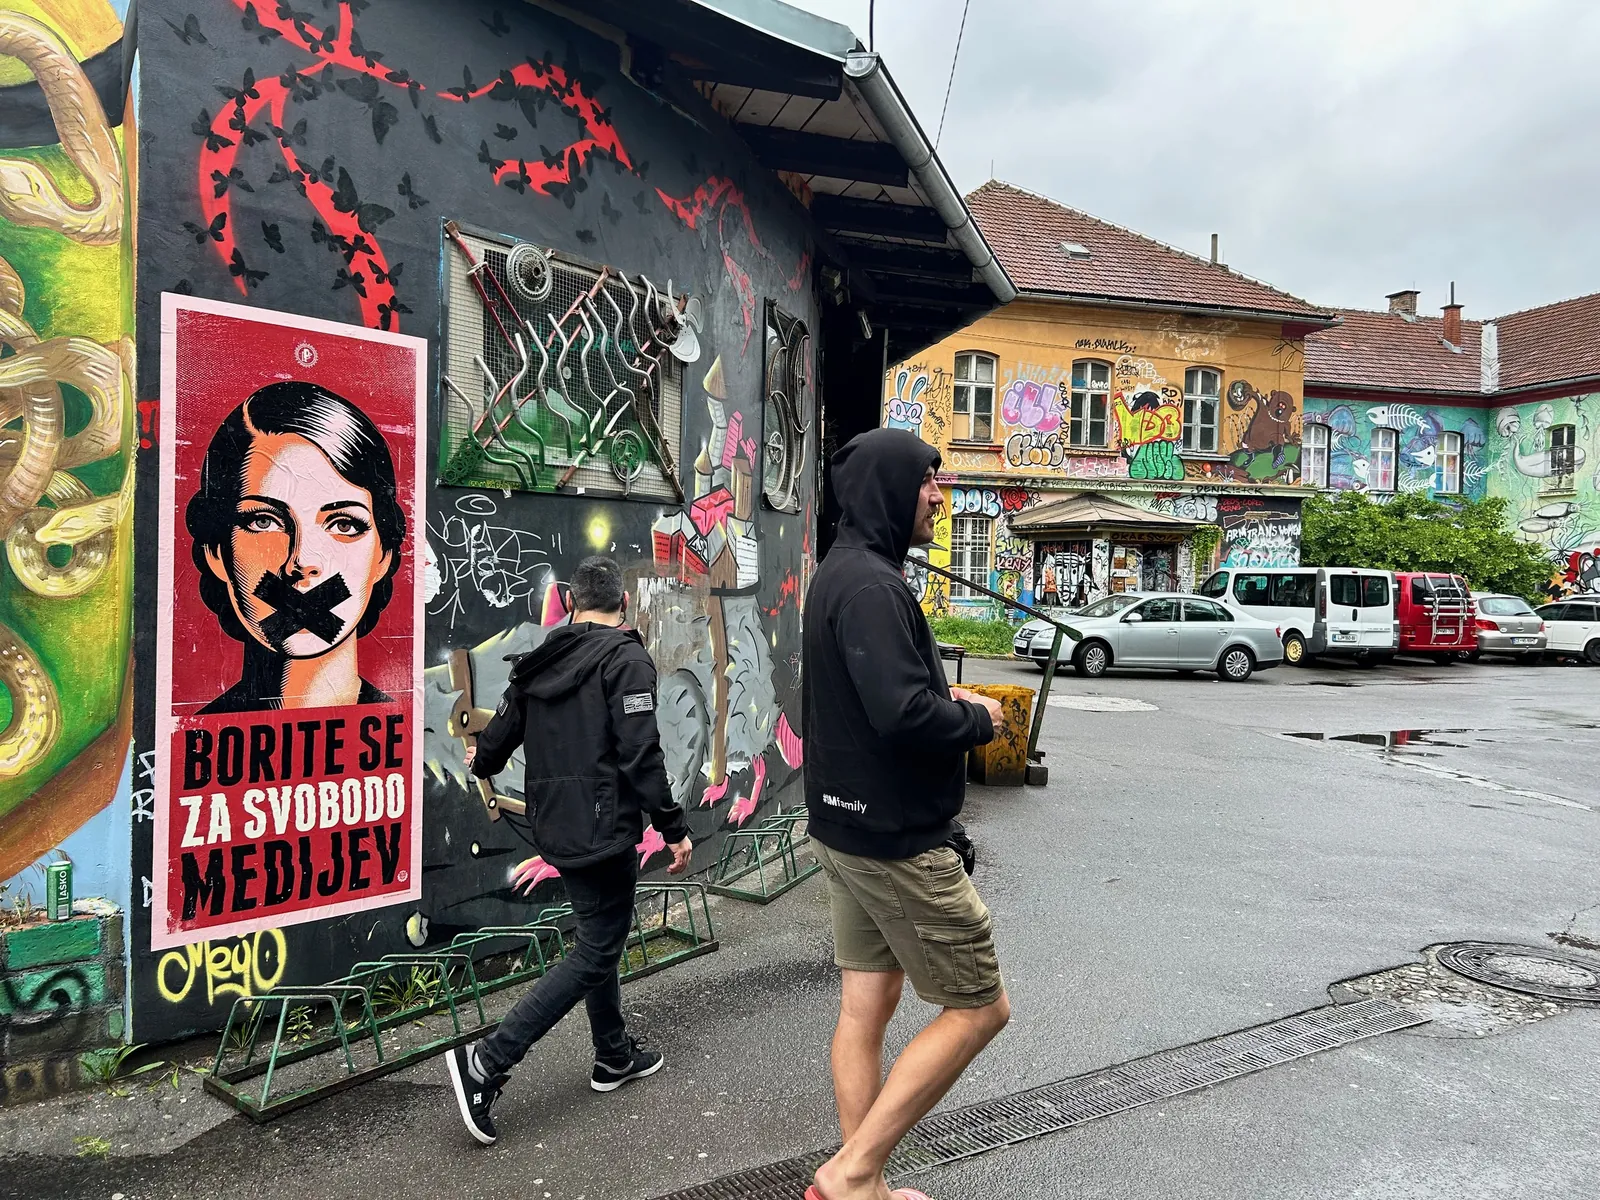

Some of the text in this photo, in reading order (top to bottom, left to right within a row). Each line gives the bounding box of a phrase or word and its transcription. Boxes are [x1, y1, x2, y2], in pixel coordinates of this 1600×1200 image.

[1225, 526, 1247, 543] ARM
[1247, 522, 1278, 541] TRANS
[183, 718, 345, 791] BORITE
[359, 714, 404, 773] SE
[179, 792, 232, 848] ZA
[243, 773, 405, 840] SVOBODO
[57, 870, 67, 900] LAŠKO
[180, 822, 402, 922] MEDIJEV
